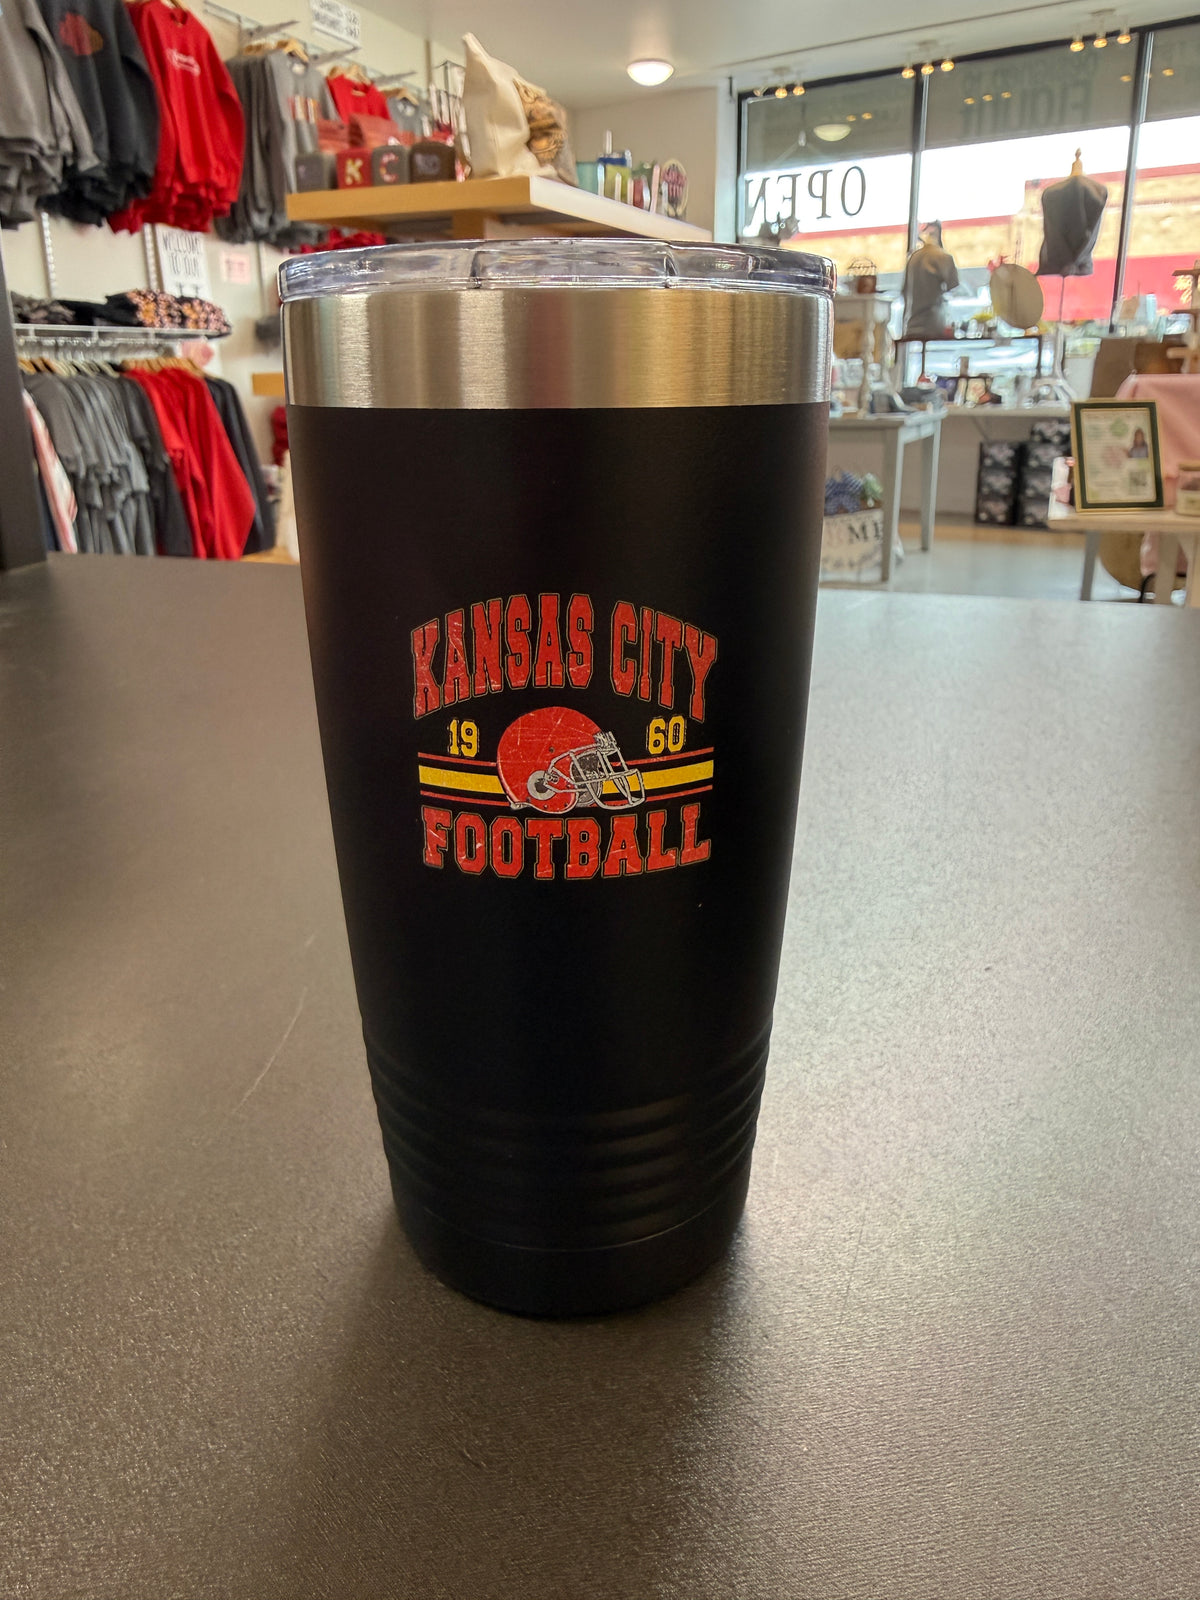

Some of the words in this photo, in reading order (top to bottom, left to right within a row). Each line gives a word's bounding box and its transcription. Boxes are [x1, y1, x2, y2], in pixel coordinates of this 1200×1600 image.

[411, 593, 594, 720] KANSAS
[610, 600, 718, 724] CITY
[447, 717, 480, 758] 19
[646, 714, 687, 755] 60
[420, 802, 712, 880] FOOTBALL
